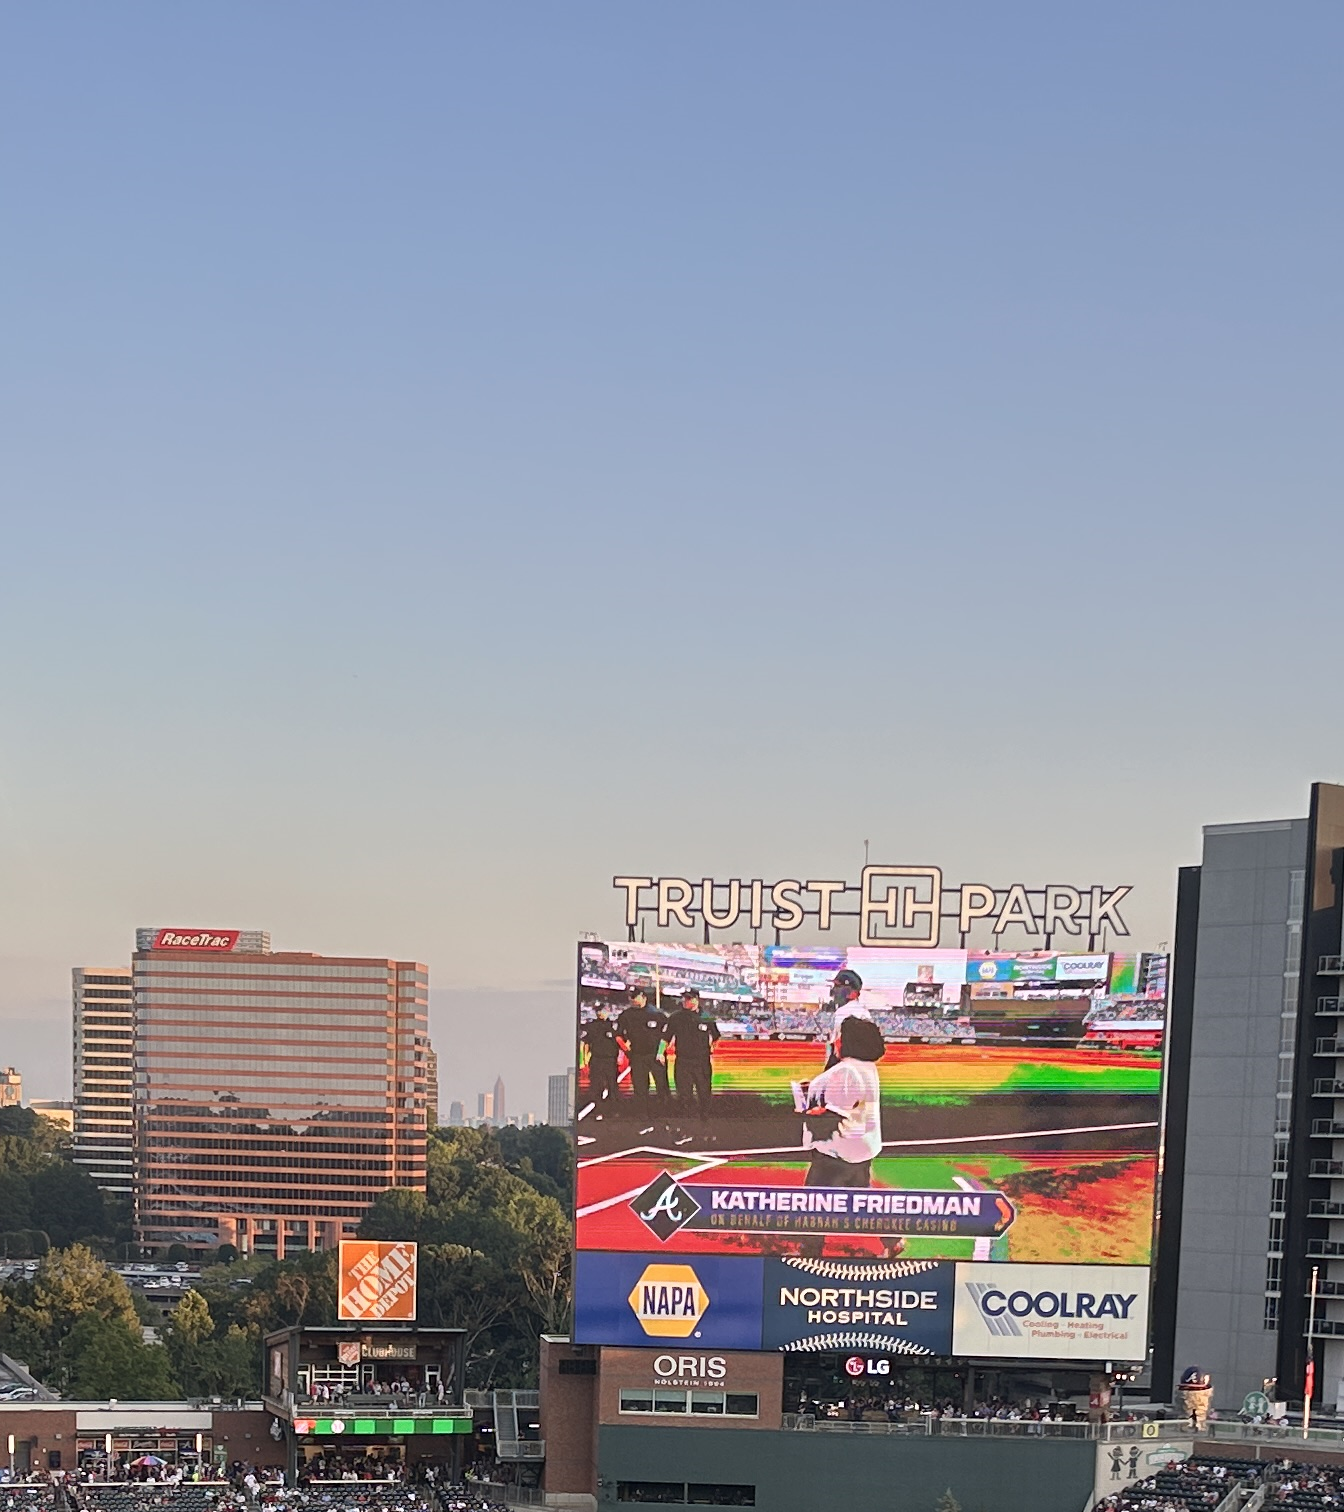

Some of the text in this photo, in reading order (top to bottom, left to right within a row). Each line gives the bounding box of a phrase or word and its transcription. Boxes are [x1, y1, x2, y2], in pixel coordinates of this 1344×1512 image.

[613, 876, 1134, 935] TRUIST PARK
[161, 932, 230, 949] RaceTrac
[712, 1191, 981, 1216] KATHERINE FRIEDMAN
[711, 1214, 725, 1226] ON
[730, 1214, 771, 1227] BEHALF
[776, 1215, 790, 1227] OF
[854, 1217, 910, 1231] CHEROKEE
[348, 1250, 379, 1281] THE
[342, 1243, 414, 1317] HOME
[369, 1271, 414, 1318] DEPOT
[643, 1285, 695, 1317] NAPA
[780, 1287, 937, 1311] NORTHSIDE
[982, 1290, 1138, 1319] COOLRAY
[807, 1310, 908, 1327] HOSPITAL
[1023, 1320, 1104, 1331] Cooling Heating
[1032, 1330, 1128, 1340] Plumbing Electrical
[654, 1355, 726, 1378] ORIS
[867, 1359, 890, 1375] LG
